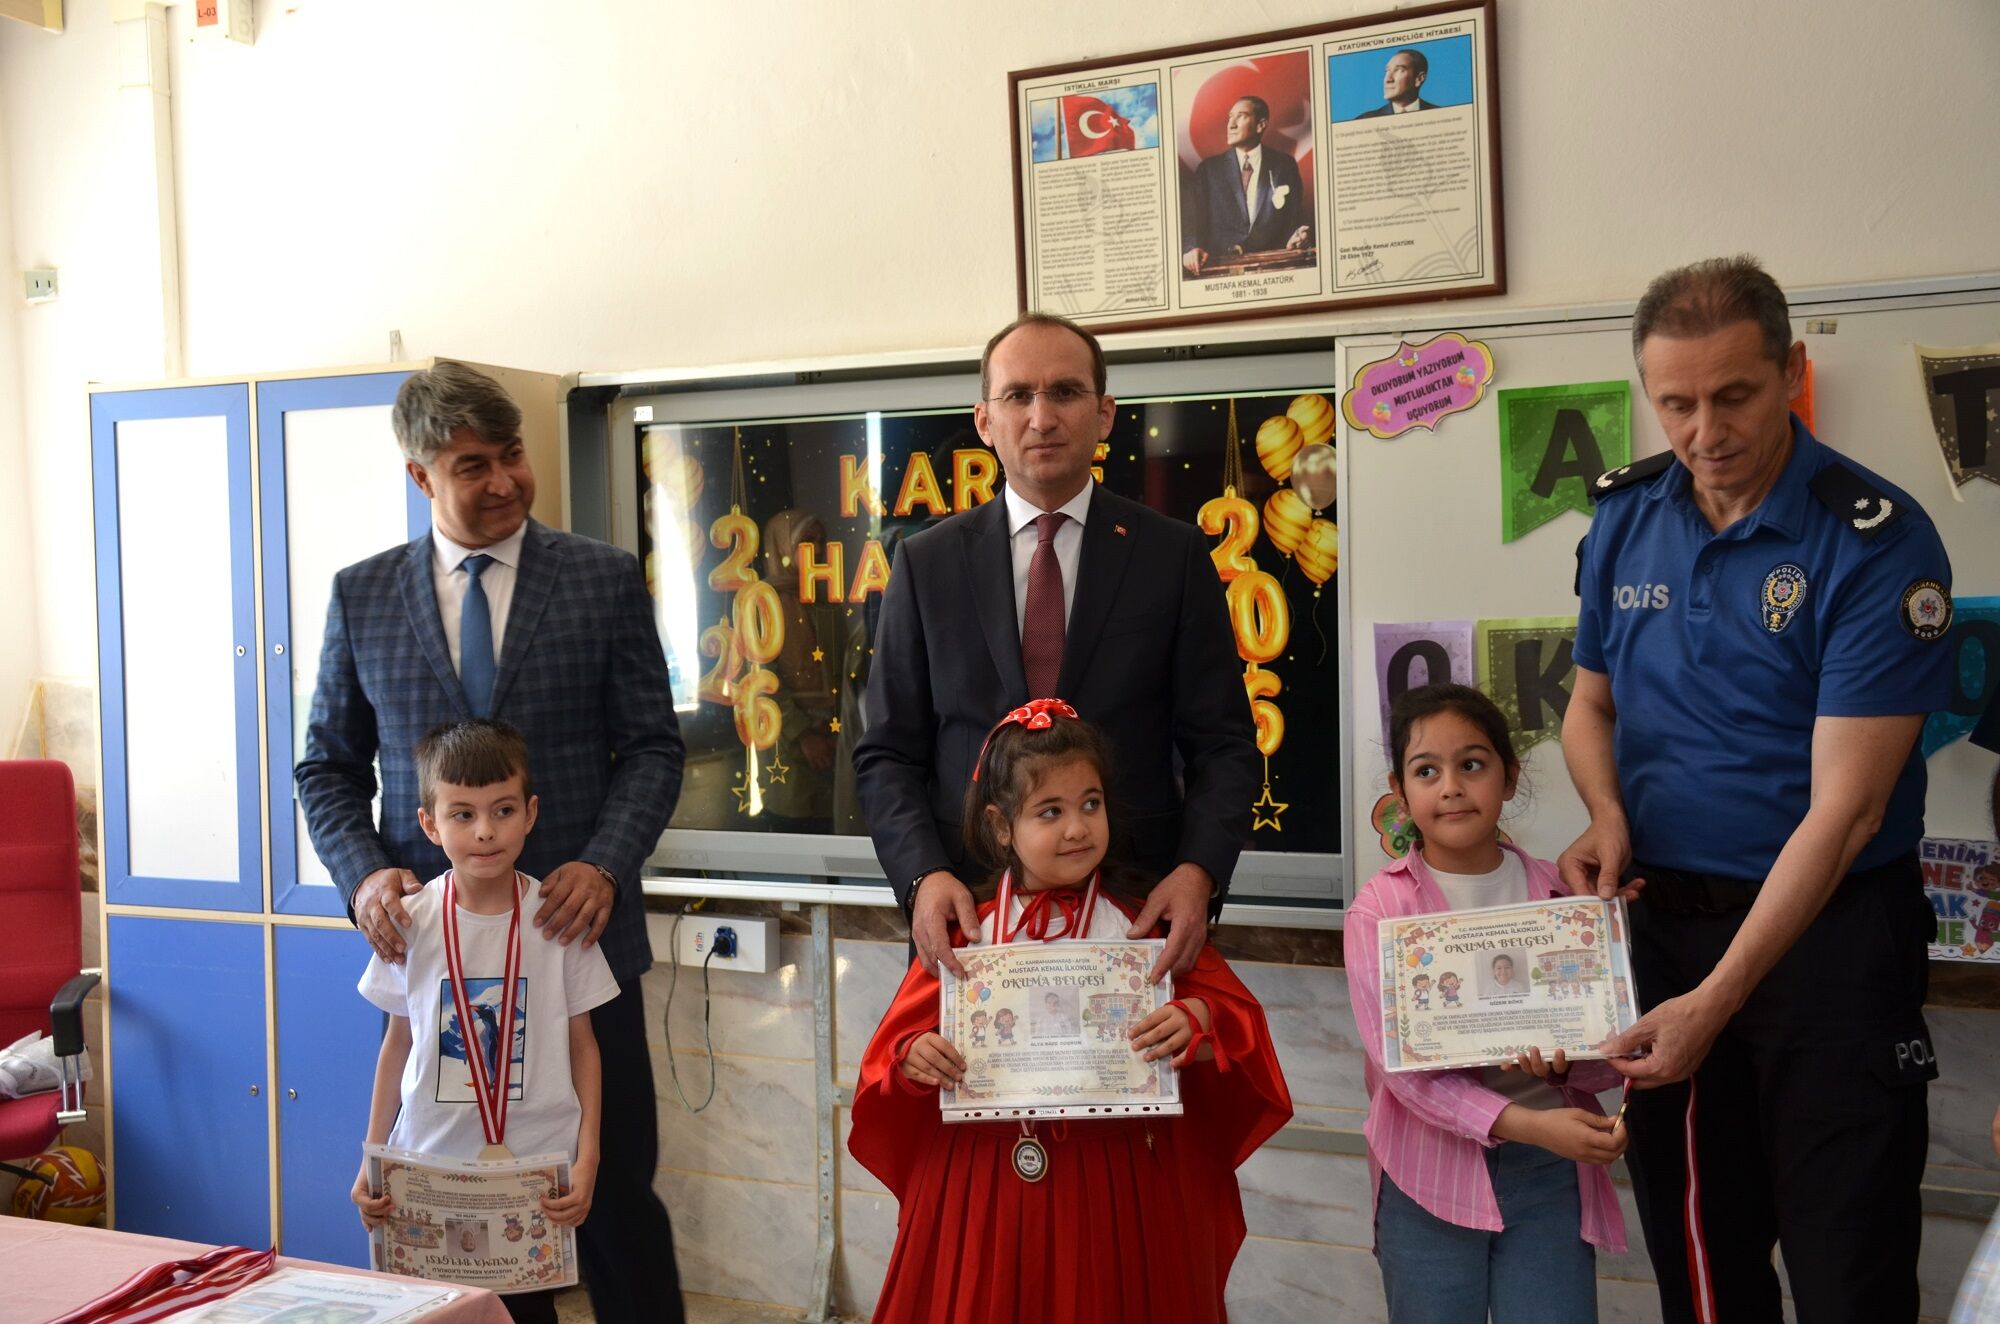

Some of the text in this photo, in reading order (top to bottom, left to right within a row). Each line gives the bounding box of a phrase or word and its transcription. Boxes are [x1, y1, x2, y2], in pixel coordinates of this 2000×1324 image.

[198, 6, 217, 18] L-03
[1338, 25, 1462, 51] ATATÜRK'ÜN GENÇLİĞE HİTABESİ
[1064, 82, 1096, 92] İSTİKLAL
[1205, 275, 1294, 291] MUSTAFA KEMAL ATATÜRK
[1232, 290, 1246, 298] 1881
[1252, 288, 1268, 296] 1938
[1370, 351, 1465, 396] OKUYORUM YAZIYORUM
[1393, 375, 1454, 407] MUTLULUKTAN
[1406, 395, 1453, 421] UÇUYORUM
[1932, 364, 2000, 469] T
[1530, 409, 1607, 506] A
[1776, 567, 1801, 579] POLİS
[1919, 842, 1989, 866] ENİM
[1451, 925, 1546, 940] MUSTAFA KEMAL İLKOKULU
[1444, 932, 1555, 954] OKUMA BELGESİ
[1065, 964, 1098, 972] İLKOKULU
[1001, 973, 1105, 989] OKUMA BELGESİ
[425, 1255, 519, 1268] OKUMA BELGESİ
[432, 1267, 461, 1275] İLKOKULU
